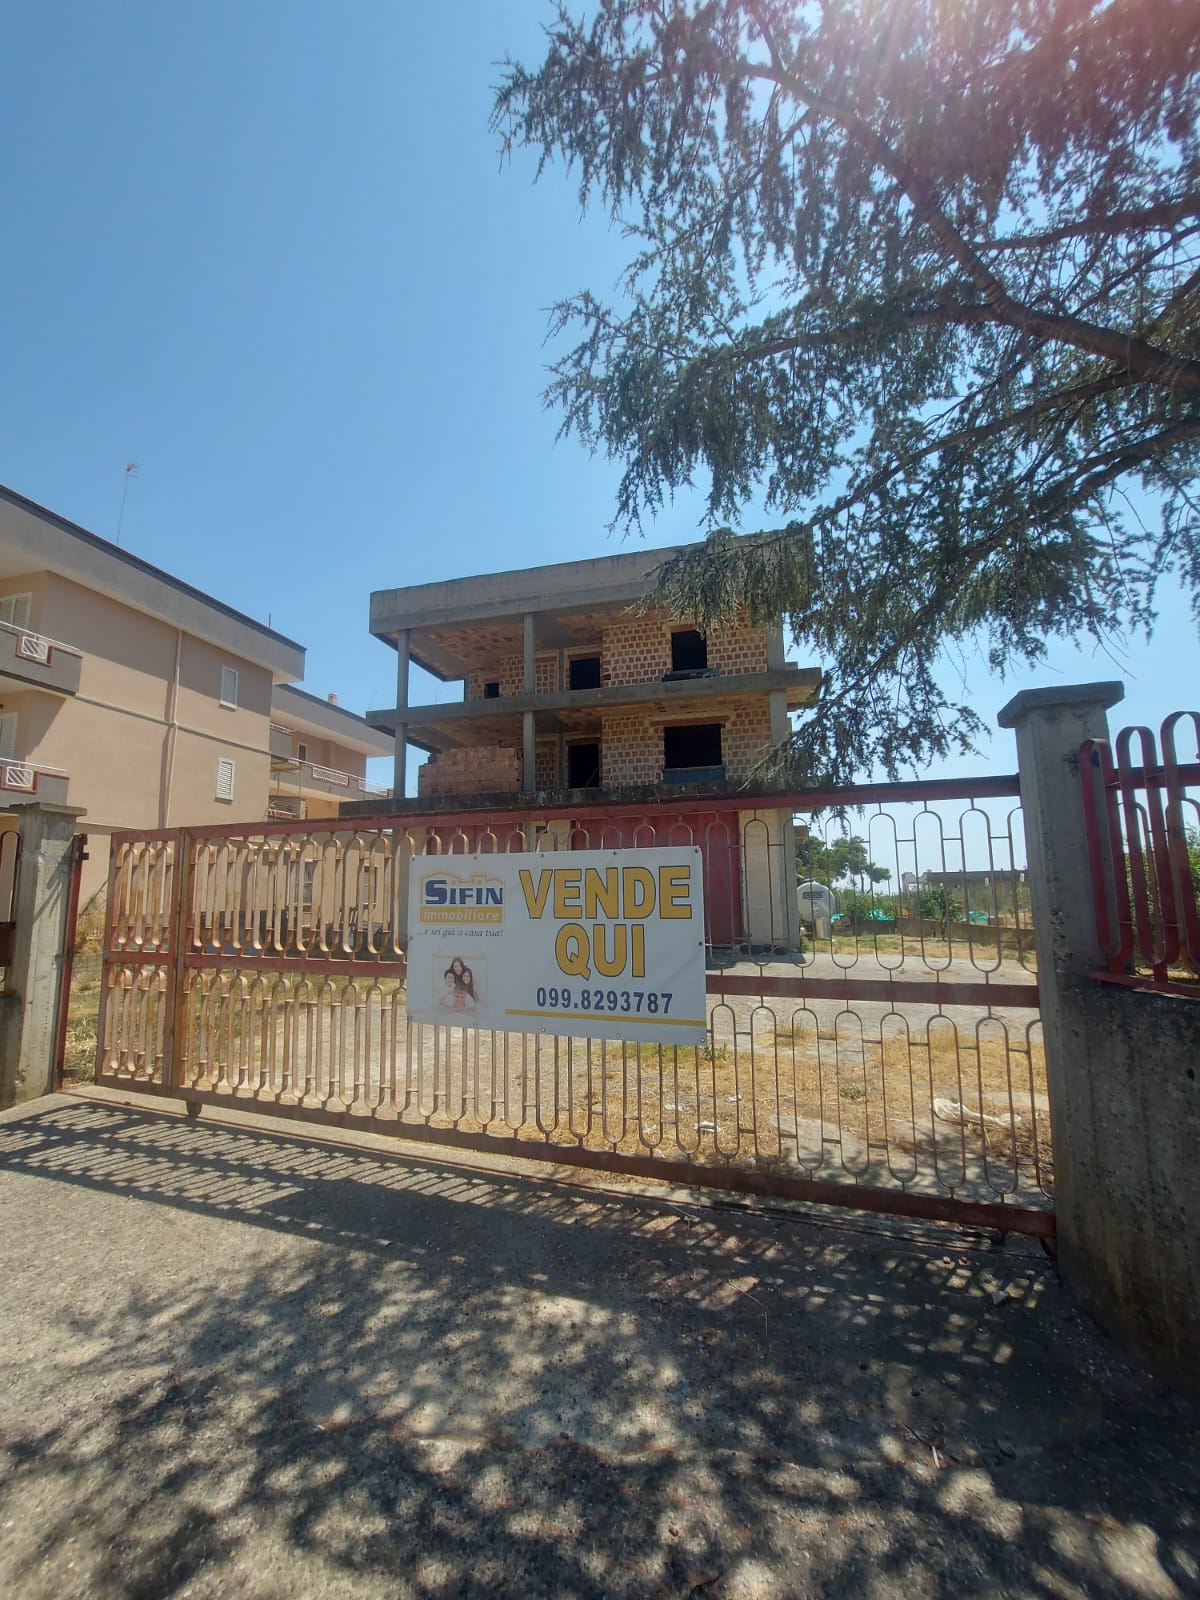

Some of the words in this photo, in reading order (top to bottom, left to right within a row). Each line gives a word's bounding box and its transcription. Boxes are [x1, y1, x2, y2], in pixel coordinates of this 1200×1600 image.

[425, 879, 503, 905] SIFIN
[519, 865, 693, 919] VENDE
[423, 908, 499, 921] immobiliare
[465, 929, 483, 937] casa
[485, 929, 504, 937] tua!
[555, 923, 646, 981] QUI
[536, 987, 673, 1014] 099.8293787
